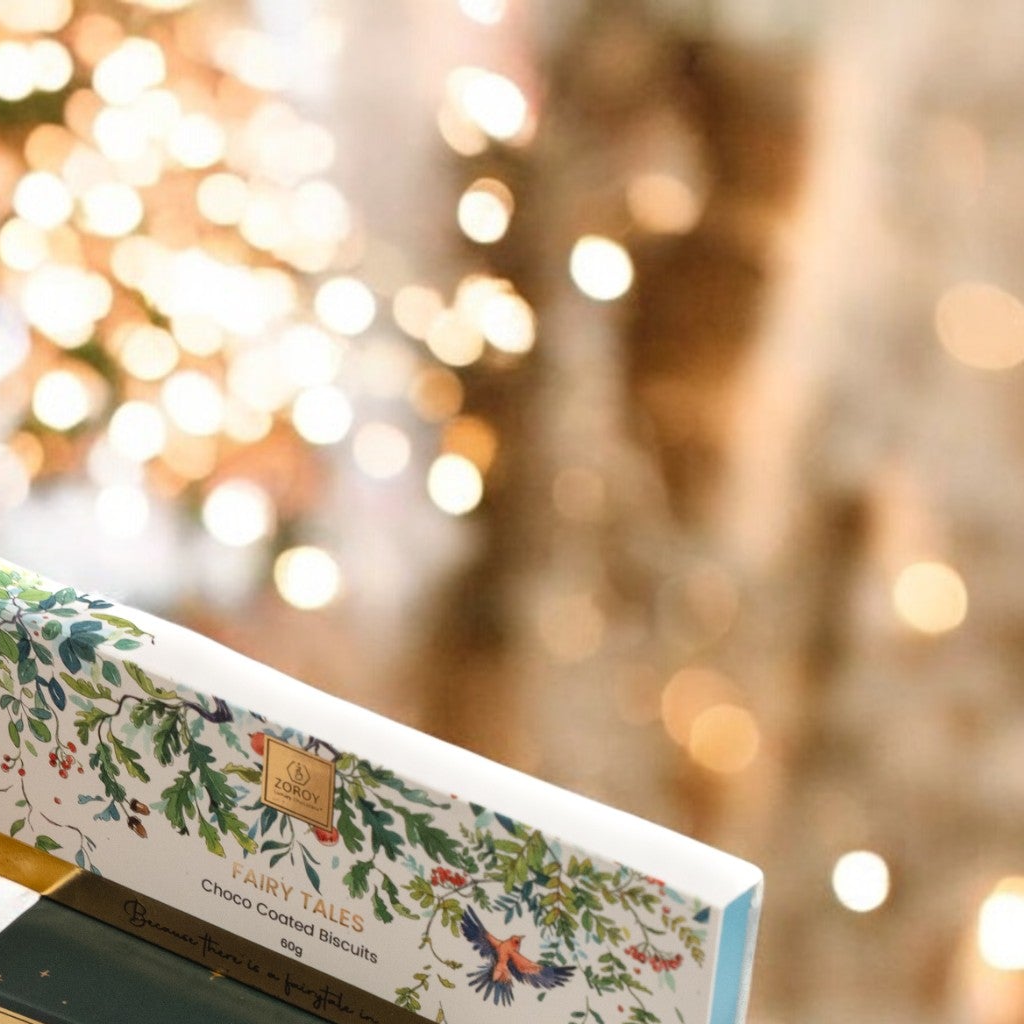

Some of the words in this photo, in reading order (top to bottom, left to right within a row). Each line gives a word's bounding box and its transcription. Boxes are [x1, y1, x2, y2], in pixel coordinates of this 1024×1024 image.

[274, 777, 320, 804] ZOROY
[201, 879, 252, 909] Choco
[257, 902, 315, 937] Coated
[319, 929, 378, 964] Biscuits
[231, 861, 294, 902] FAIRY
[300, 891, 365, 933] TALES
[280, 938, 303, 958] 60g
